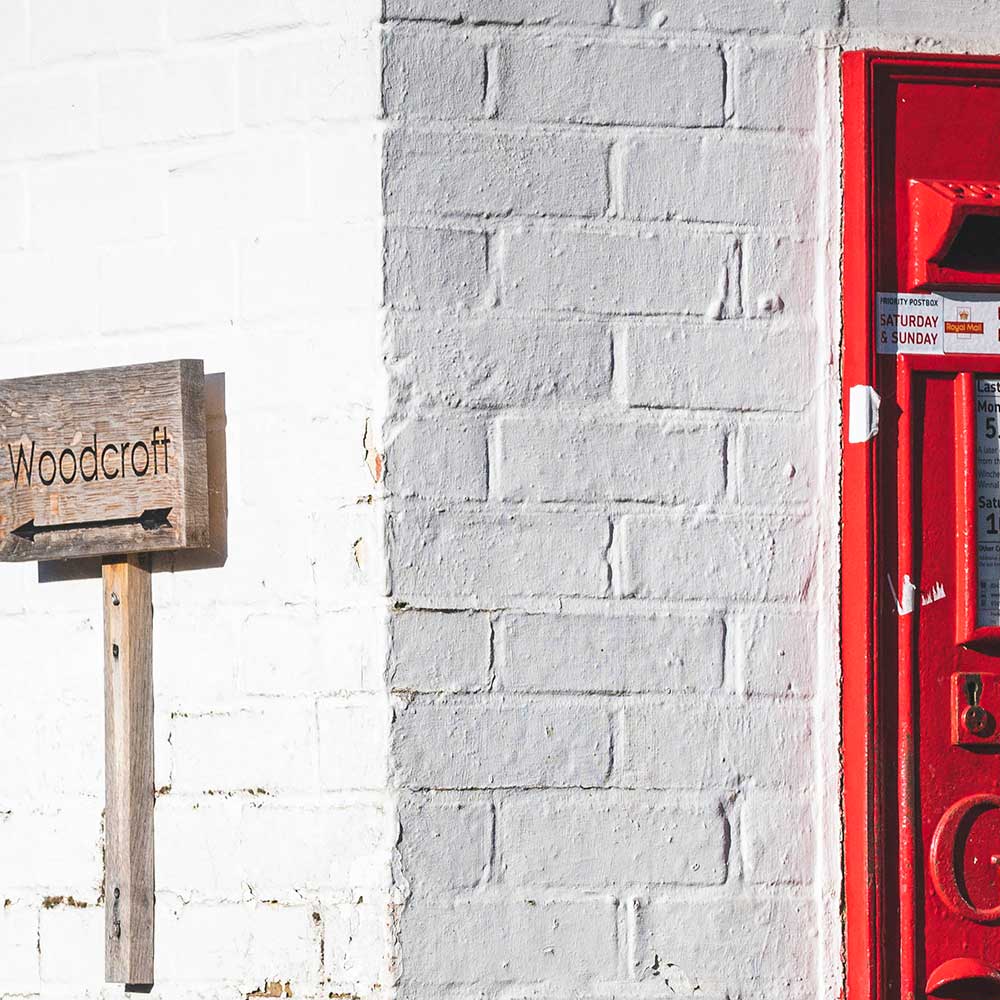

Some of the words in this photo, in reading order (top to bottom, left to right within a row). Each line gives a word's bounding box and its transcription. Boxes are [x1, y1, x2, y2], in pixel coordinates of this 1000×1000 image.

[880, 297, 908, 306] PRIORITY
[909, 298, 938, 307] POSTBOX
[880, 313, 939, 328] SATURDAY
[946, 322, 966, 333] Royal
[967, 323, 982, 332] Mail
[880, 332, 888, 344] &
[891, 332, 938, 345] SUNDAY
[977, 381, 1000, 393] Last
[7, 426, 171, 489] Woodcroft
